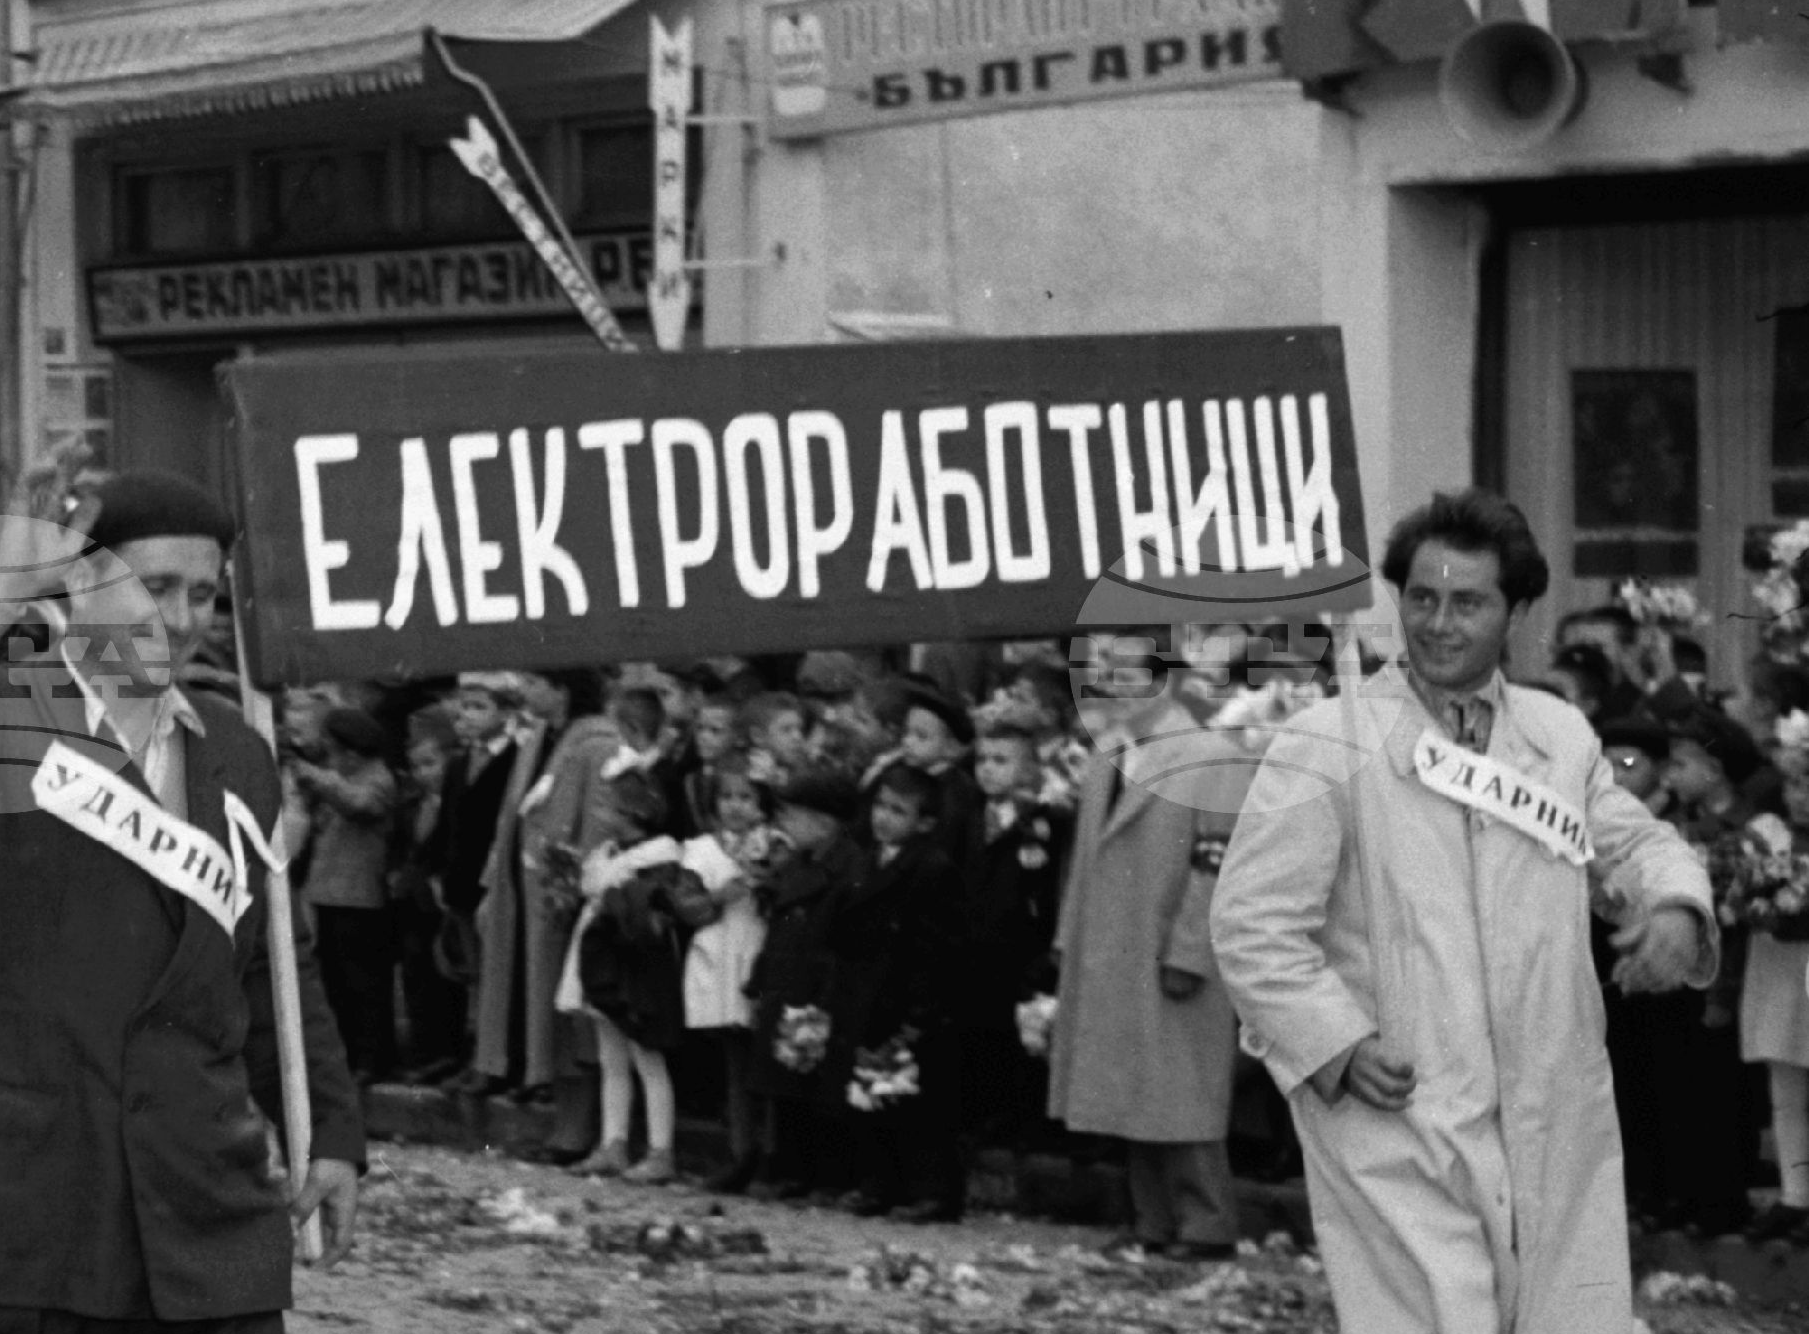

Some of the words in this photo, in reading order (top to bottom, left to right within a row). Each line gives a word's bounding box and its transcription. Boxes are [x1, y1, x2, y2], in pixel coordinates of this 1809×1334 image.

[158, 259, 358, 322] РЕКЛАМЕН
[375, 247, 555, 310] МАГАЗИ
[294, 393, 1343, 630] ЕЛЕКТРОРАБОТНИЦИ
[46, 763, 234, 906] УДАРНИ
